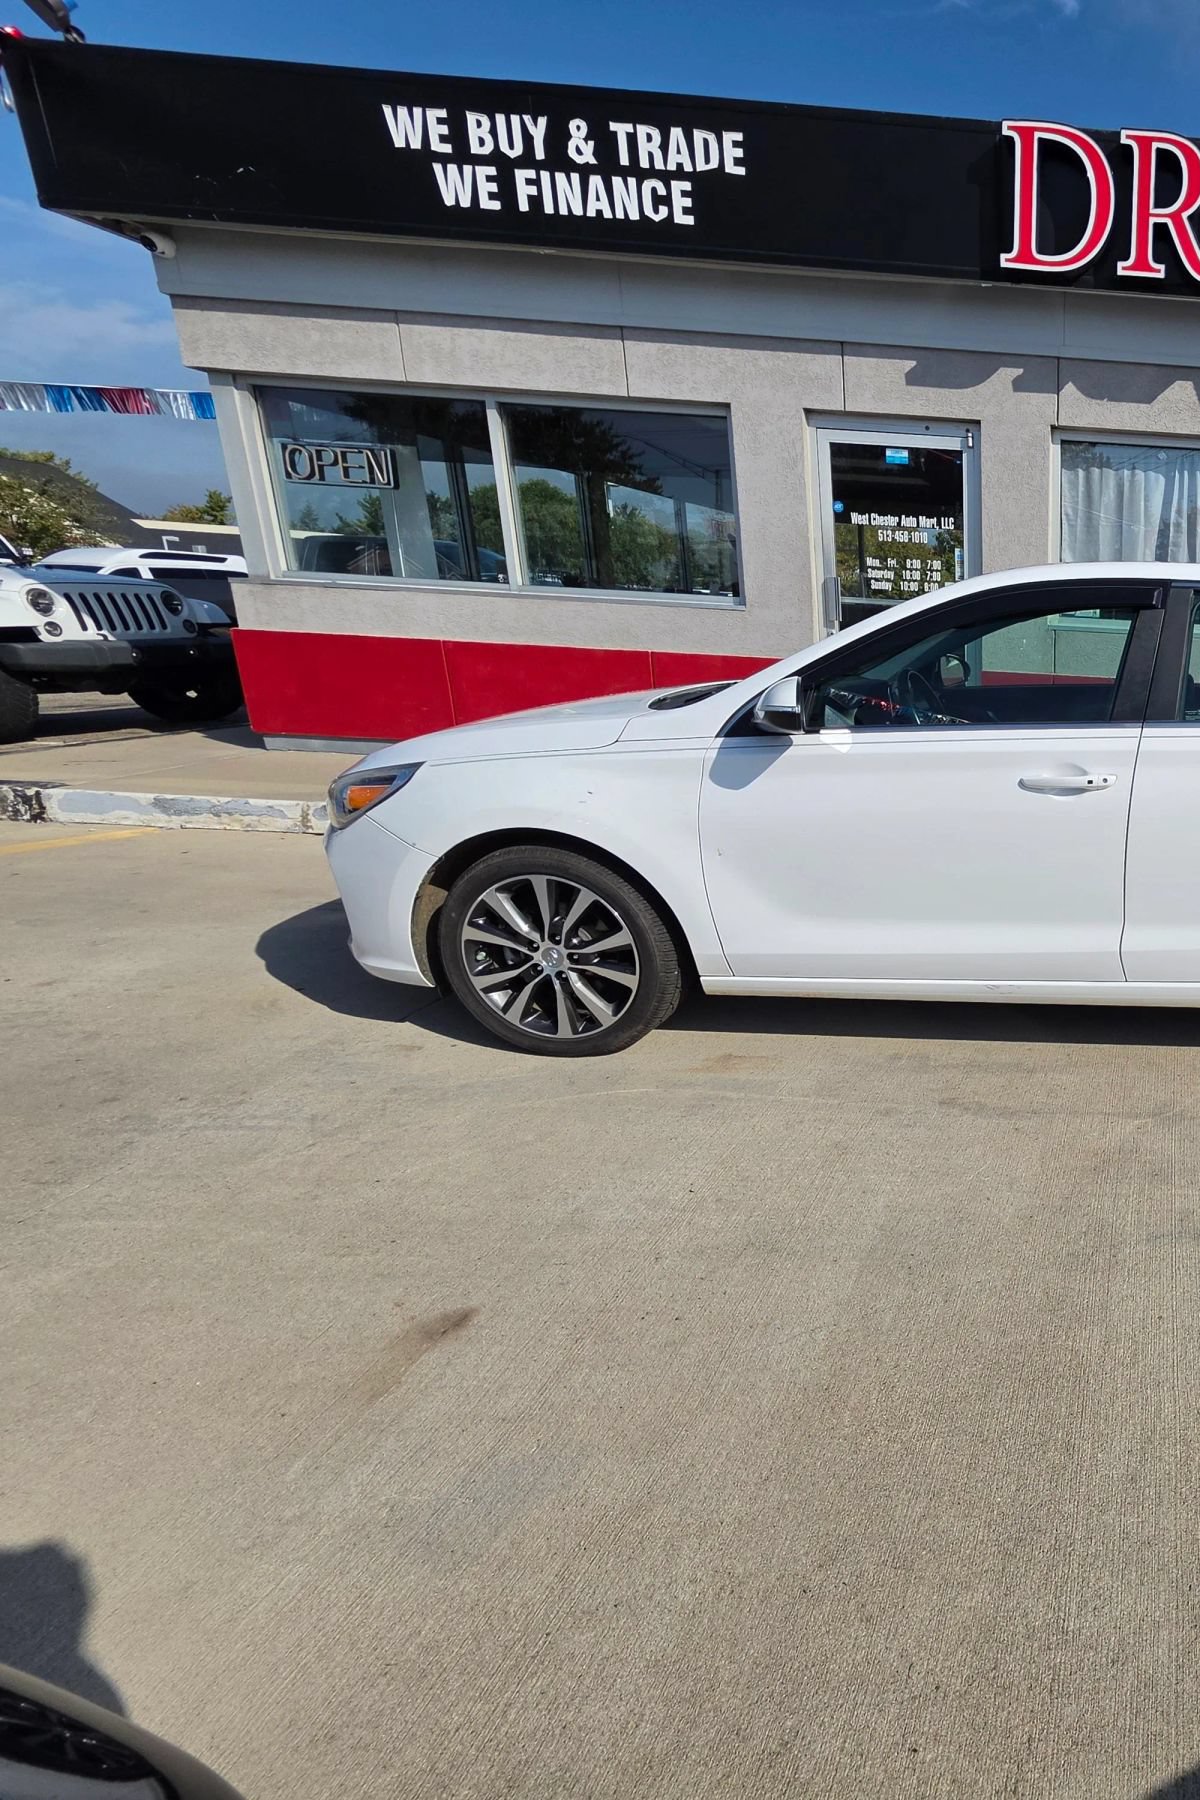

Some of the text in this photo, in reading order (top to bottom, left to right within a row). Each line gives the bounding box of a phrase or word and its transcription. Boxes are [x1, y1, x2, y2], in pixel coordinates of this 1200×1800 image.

[381, 104, 746, 176] WE BUY & TRADE
[432, 162, 695, 226] WE FINANCE
[284, 444, 389, 485] OPEN
[850, 511, 955, 530] West Chester Auto Mart, LLC
[866, 556, 882, 567] Mon.
[887, 557, 899, 568] Fri.
[926, 559, 941, 570] 7:00
[867, 568, 895, 581] Saturday
[902, 570, 921, 581] 10:00
[926, 571, 941, 582] 7:00
[870, 579, 893, 592] Sunday
[900, 581, 919, 592] 10:00
